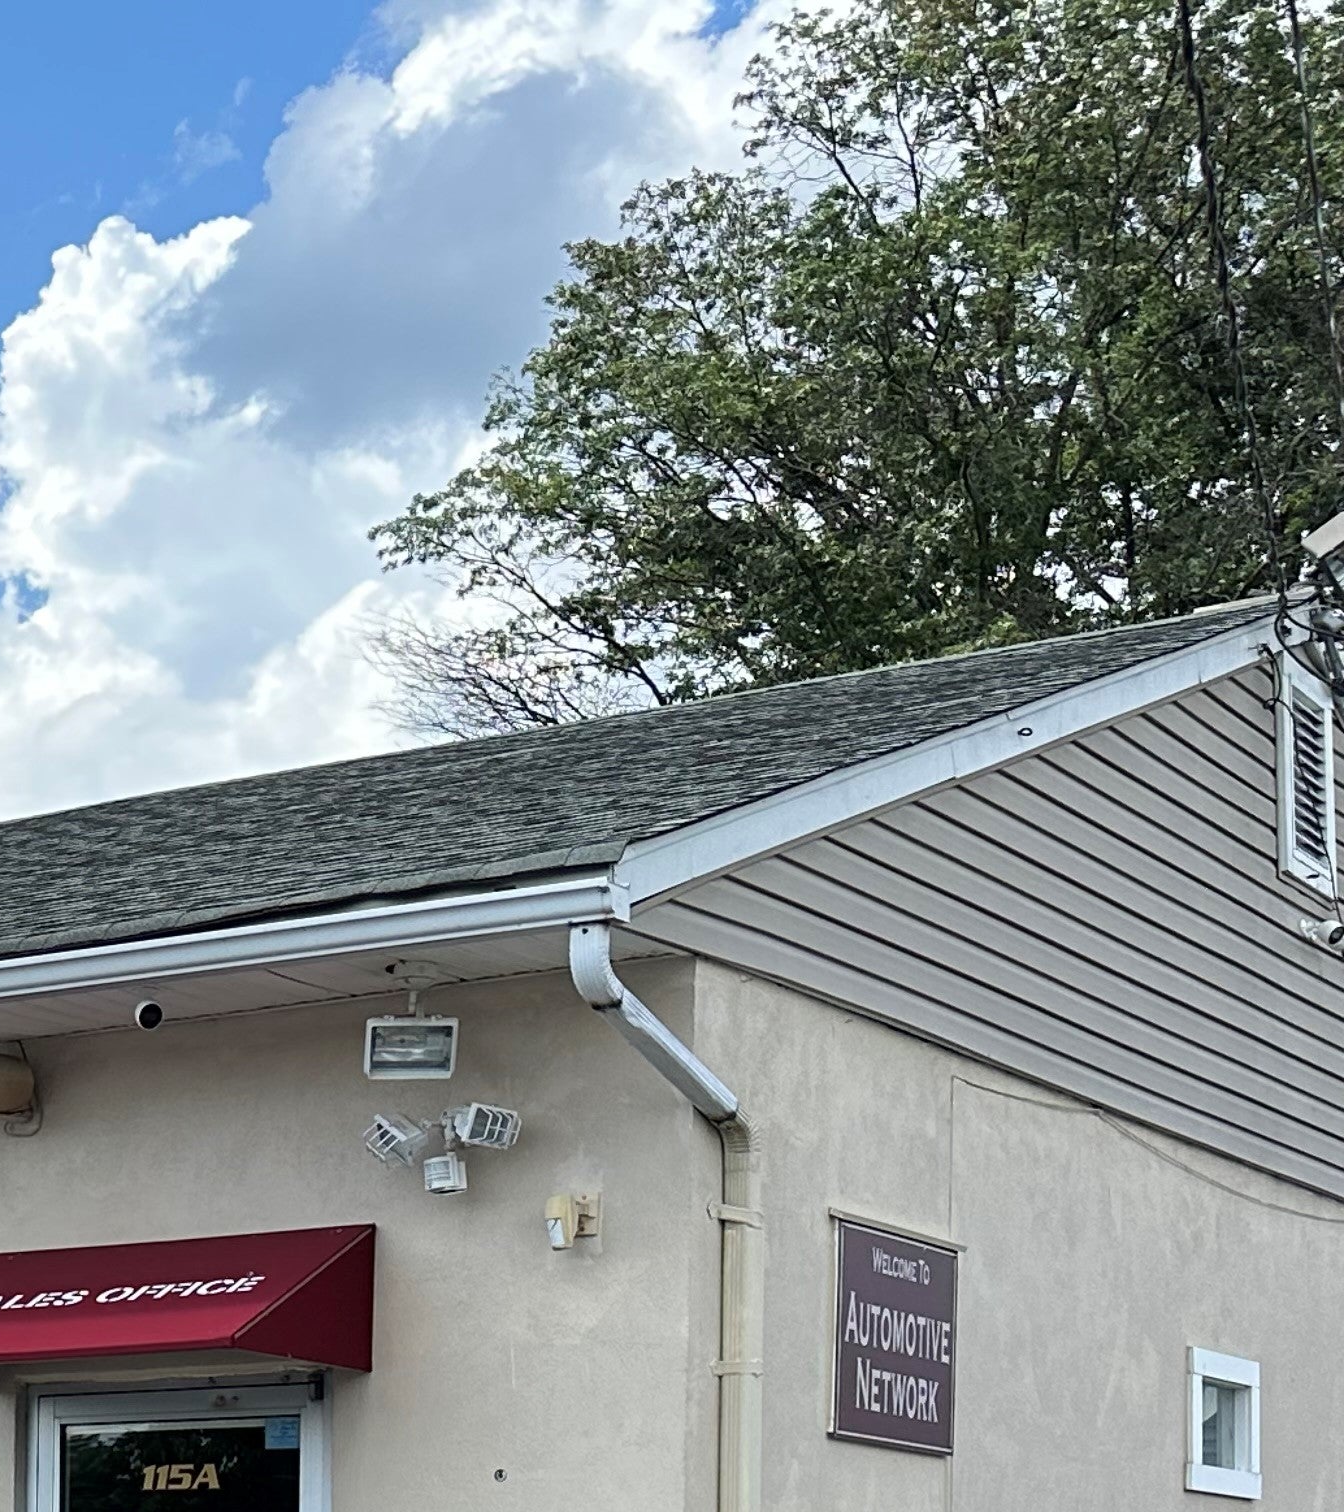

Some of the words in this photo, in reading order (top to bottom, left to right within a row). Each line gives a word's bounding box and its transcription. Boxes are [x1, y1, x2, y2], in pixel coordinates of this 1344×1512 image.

[94, 1274, 266, 1305] OFFICE
[844, 1290, 951, 1366] AUTOMOTIVE
[855, 1356, 940, 1423] NETWORK
[142, 1463, 221, 1491] 115A
